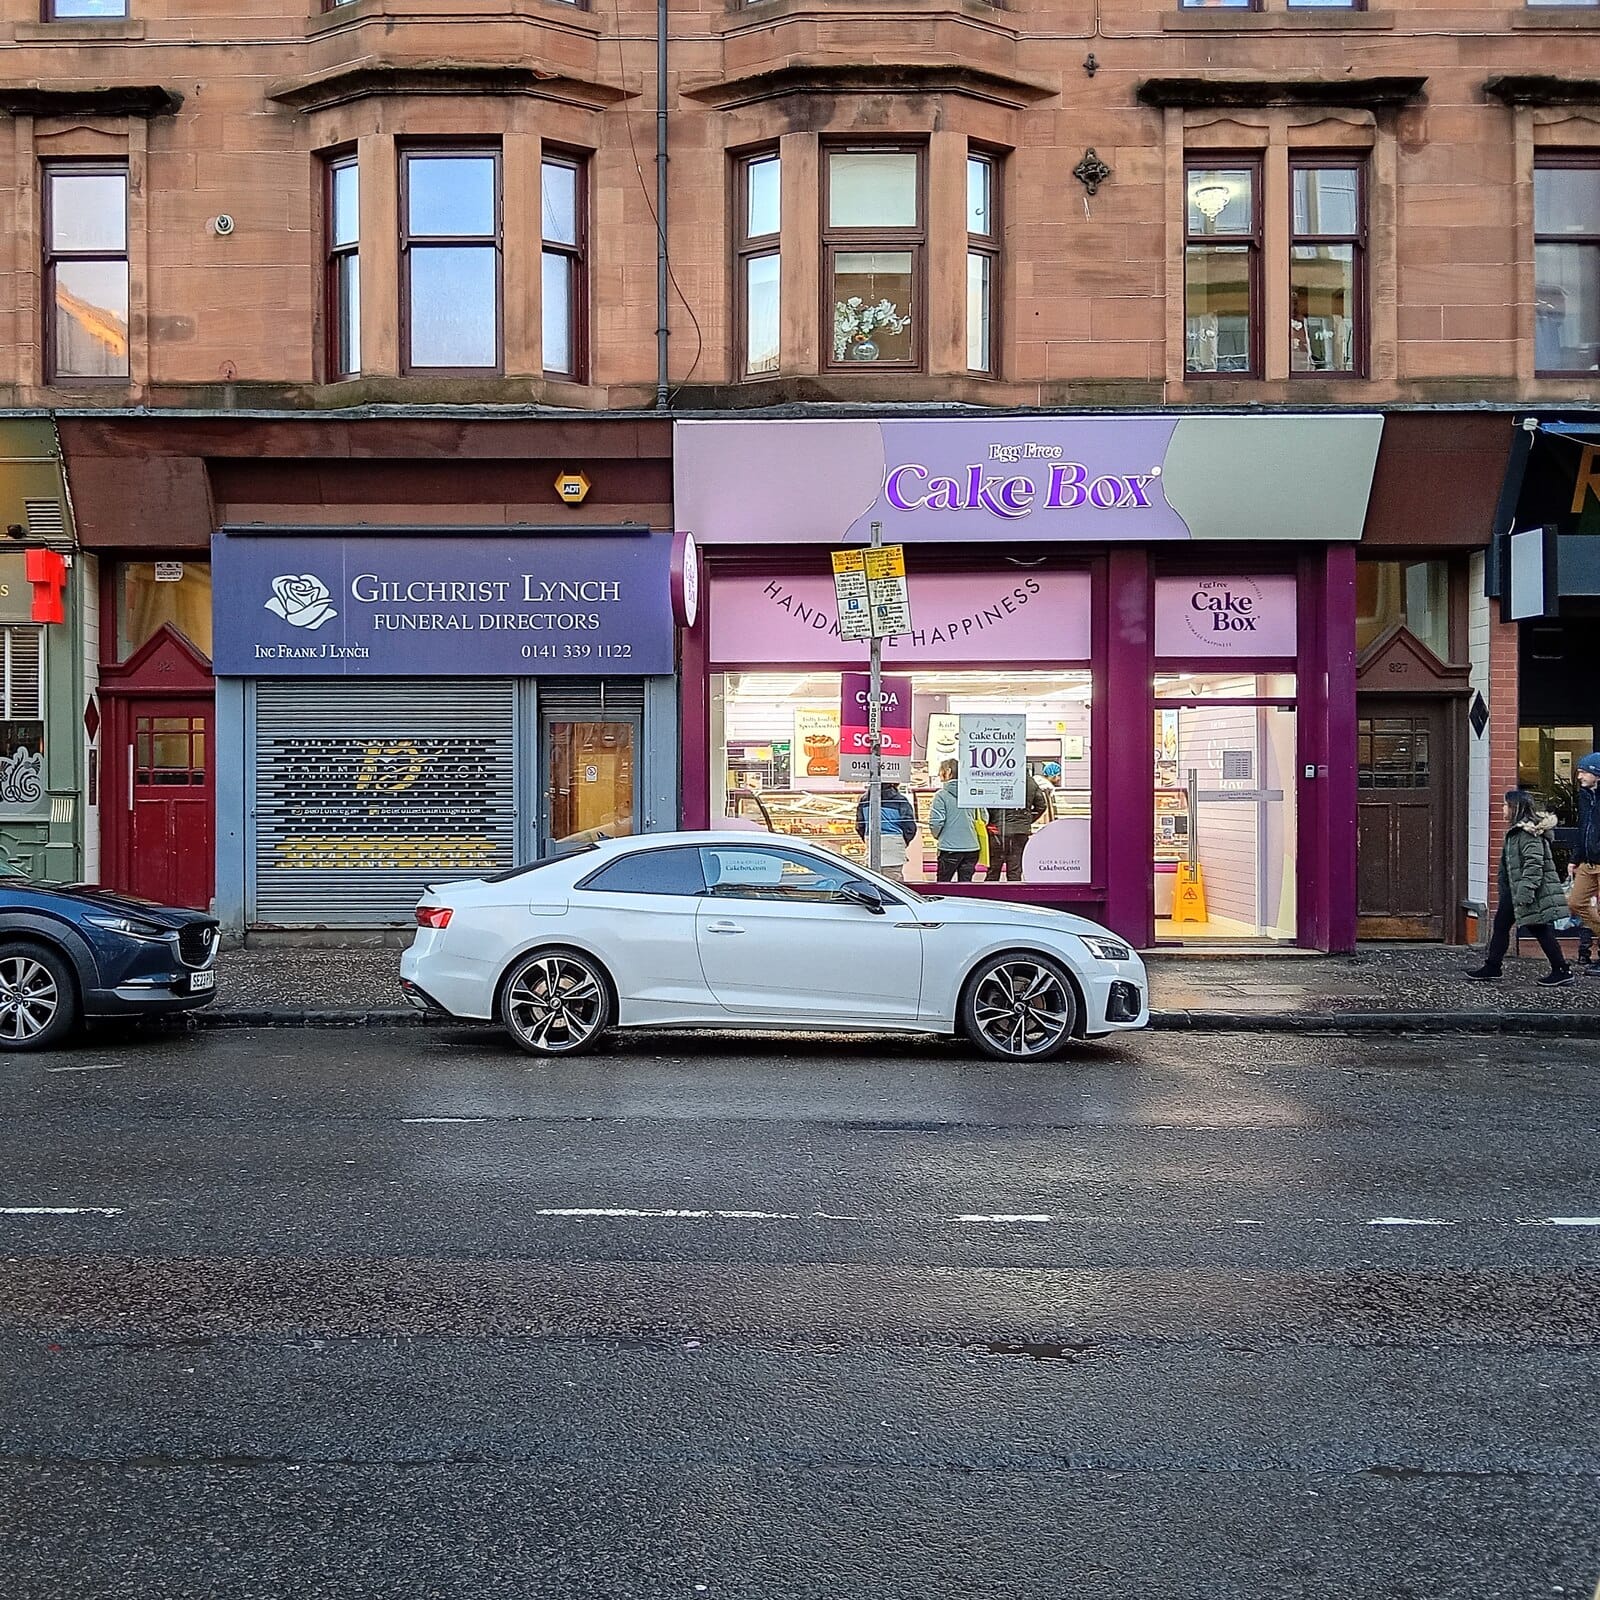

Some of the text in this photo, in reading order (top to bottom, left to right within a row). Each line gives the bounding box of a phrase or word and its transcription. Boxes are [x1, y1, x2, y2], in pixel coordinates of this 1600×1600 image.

[988, 442, 1062, 462] Egg Free
[563, 484, 580, 493] ADT
[884, 461, 1157, 520] Cake Box
[351, 573, 621, 603] GILCHRIST LYNCH
[911, 578, 1040, 647] HAPPINESS
[1191, 591, 1253, 615] Cake
[373, 613, 600, 631] FUNERAL DIRECTORS
[1212, 611, 1257, 631] Box
[254, 644, 369, 658] INC FRANK J LYNCH
[521, 644, 632, 659] 0141 339 1122
[1389, 662, 1408, 673] 827
[969, 731, 1016, 740] Cake Club!
[851, 761, 870, 770] 0141
[886, 762, 900, 771] 2111
[968, 746, 1016, 769] 10%
